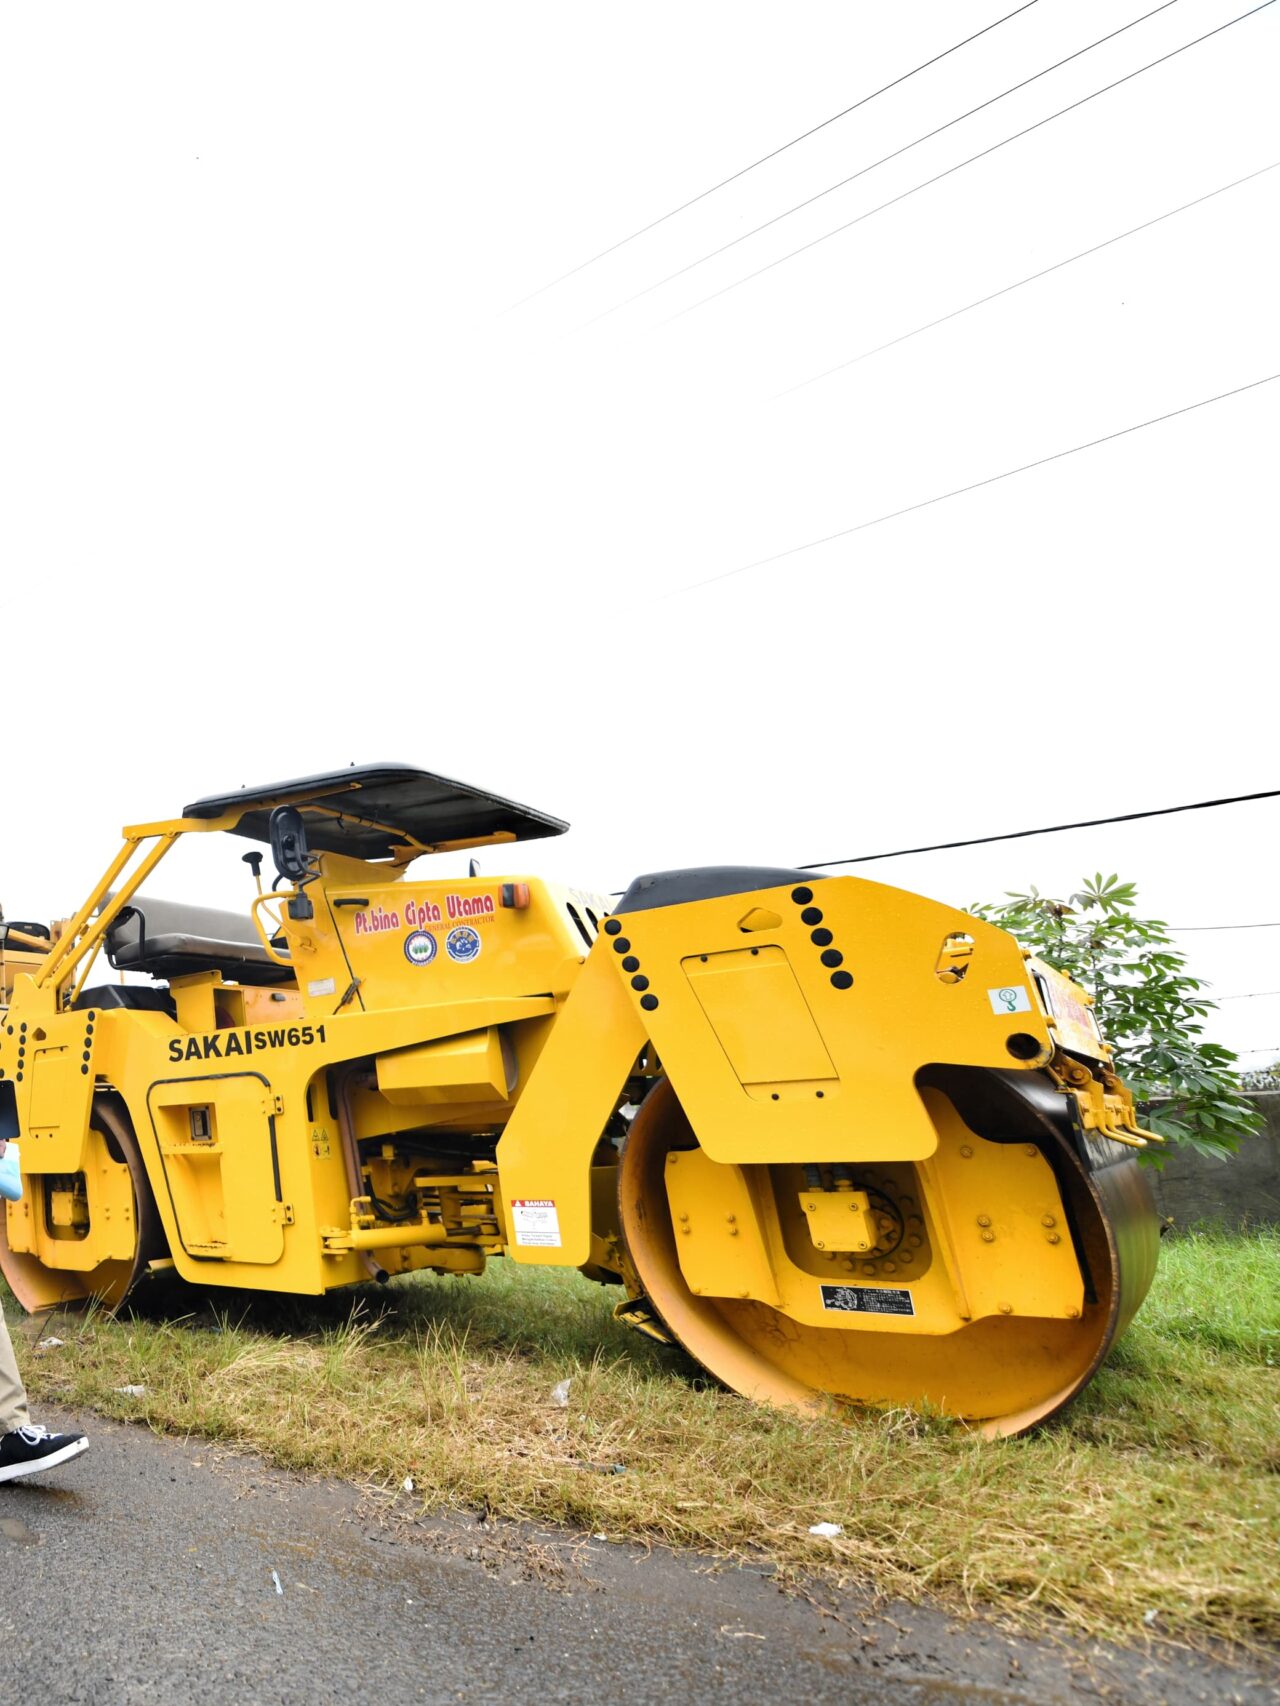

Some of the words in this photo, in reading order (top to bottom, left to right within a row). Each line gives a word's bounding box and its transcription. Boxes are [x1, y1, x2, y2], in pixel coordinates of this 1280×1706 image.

[404, 900, 441, 929] Cipta
[445, 894, 494, 919] Utama
[452, 915, 495, 928] CONTRACTOR
[168, 1030, 253, 1062] SAKAI
[254, 1024, 326, 1050] SW651
